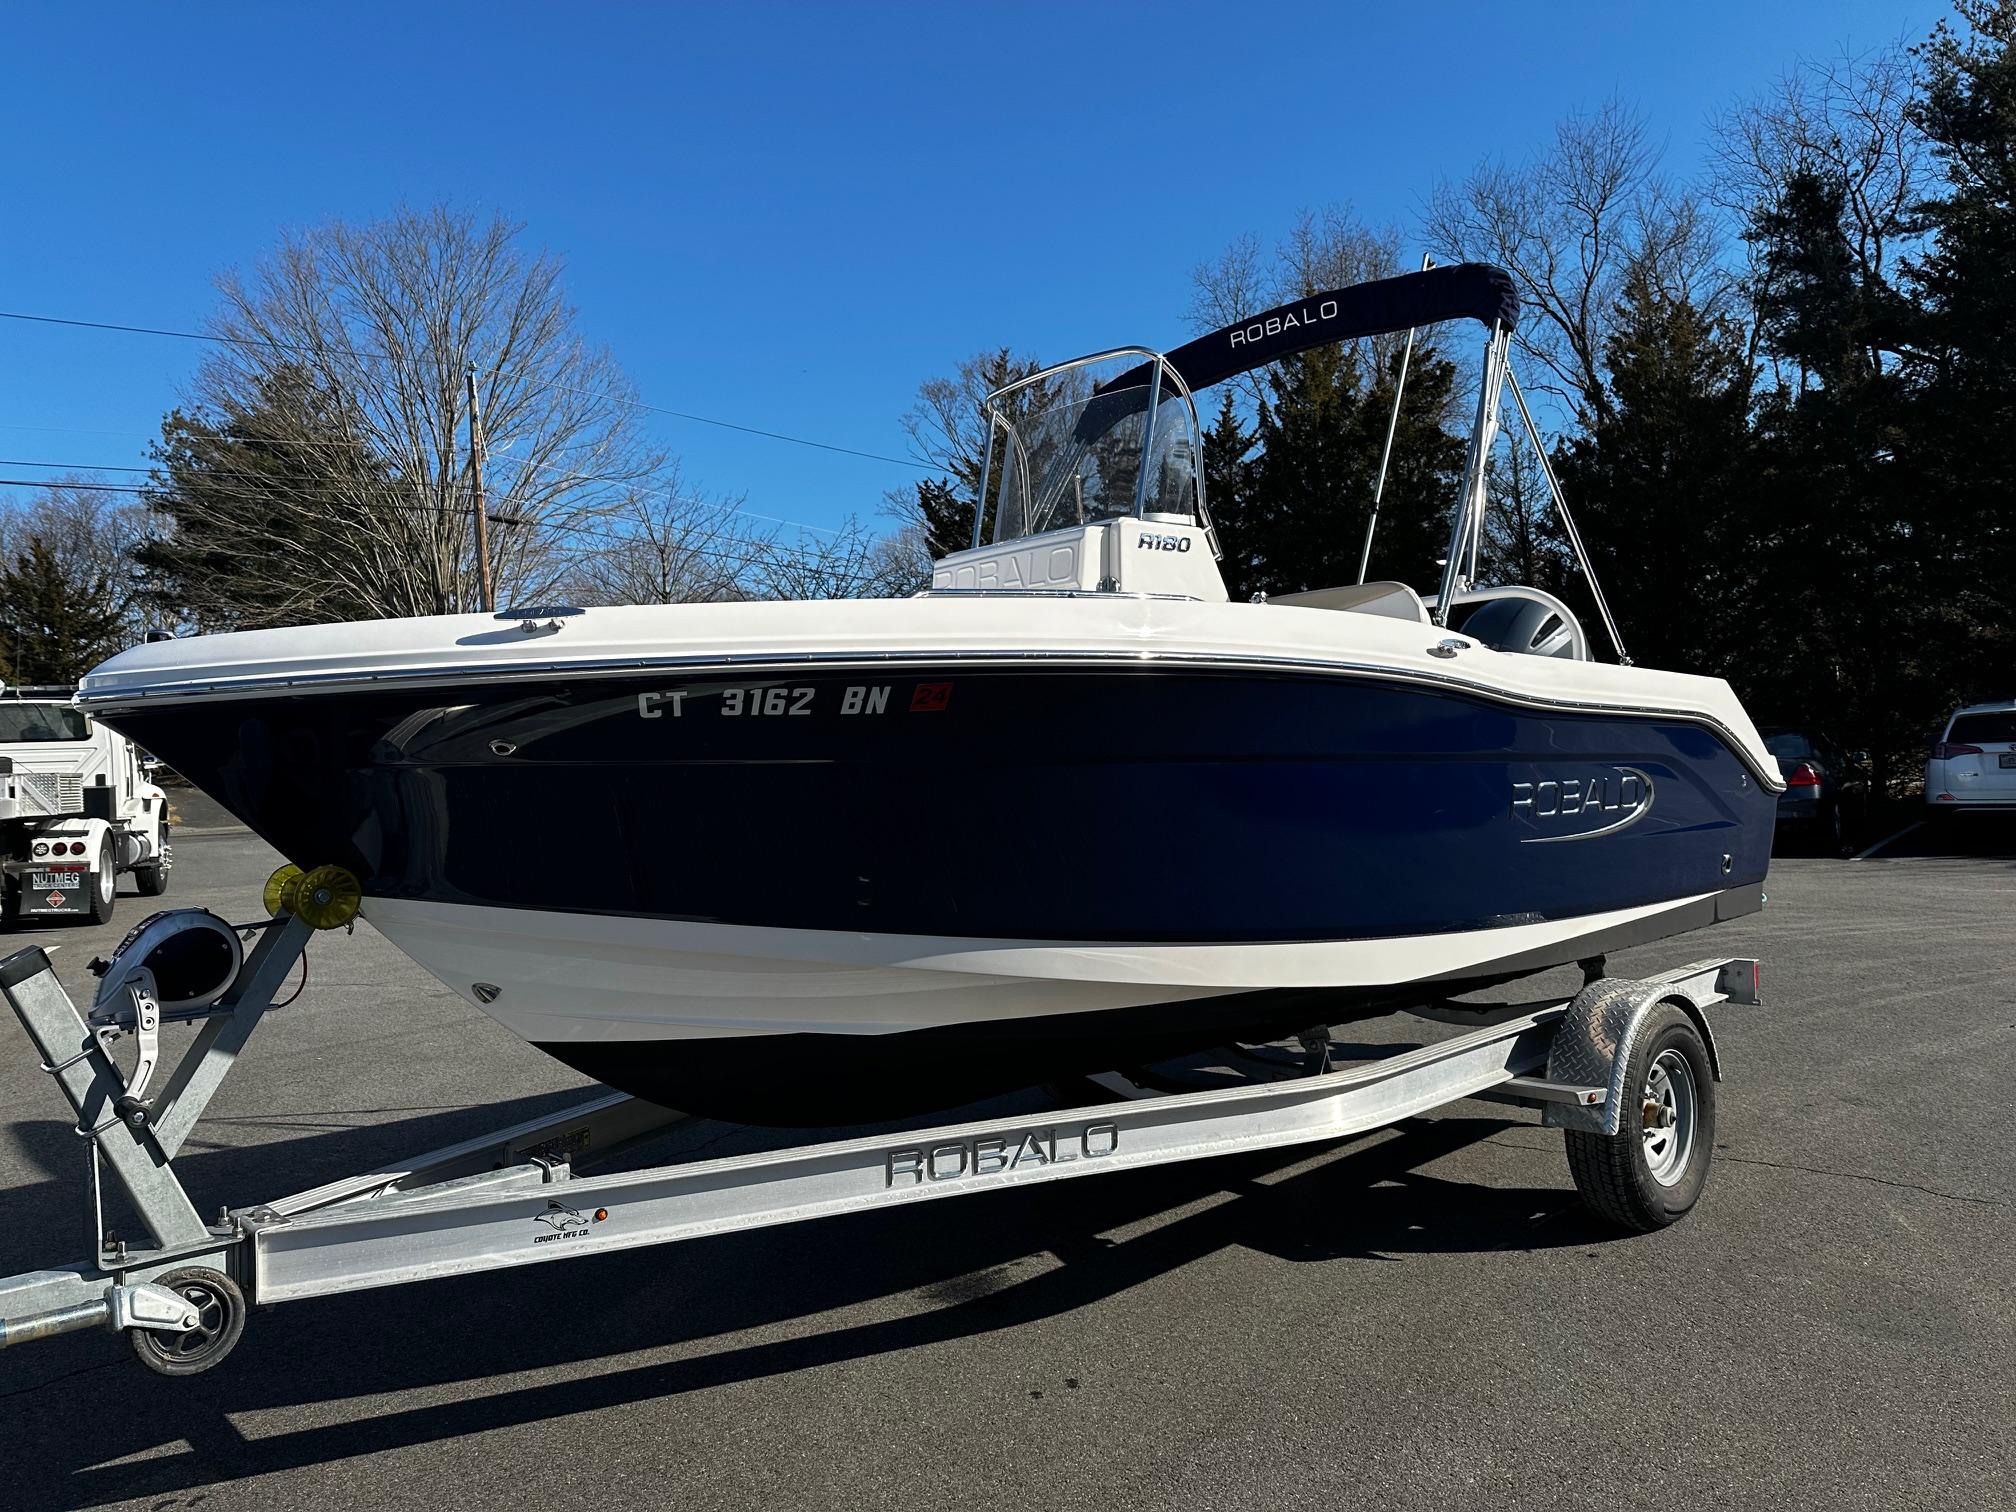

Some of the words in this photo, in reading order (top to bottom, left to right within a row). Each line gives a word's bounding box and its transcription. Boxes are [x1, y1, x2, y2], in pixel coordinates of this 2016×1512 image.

[1230, 301, 1337, 348] ROBALO
[1138, 532, 1191, 552] R180
[638, 691, 688, 718] CT
[721, 687, 816, 716] 3162
[840, 686, 892, 715] BN
[915, 687, 948, 704] 24
[1509, 776, 1639, 820] ROBALO
[32, 872, 80, 884] NUTMEG
[886, 1123, 1119, 1188] ROBALO
[534, 1233, 561, 1243] COYOTE
[563, 1230, 578, 1239] MFG
